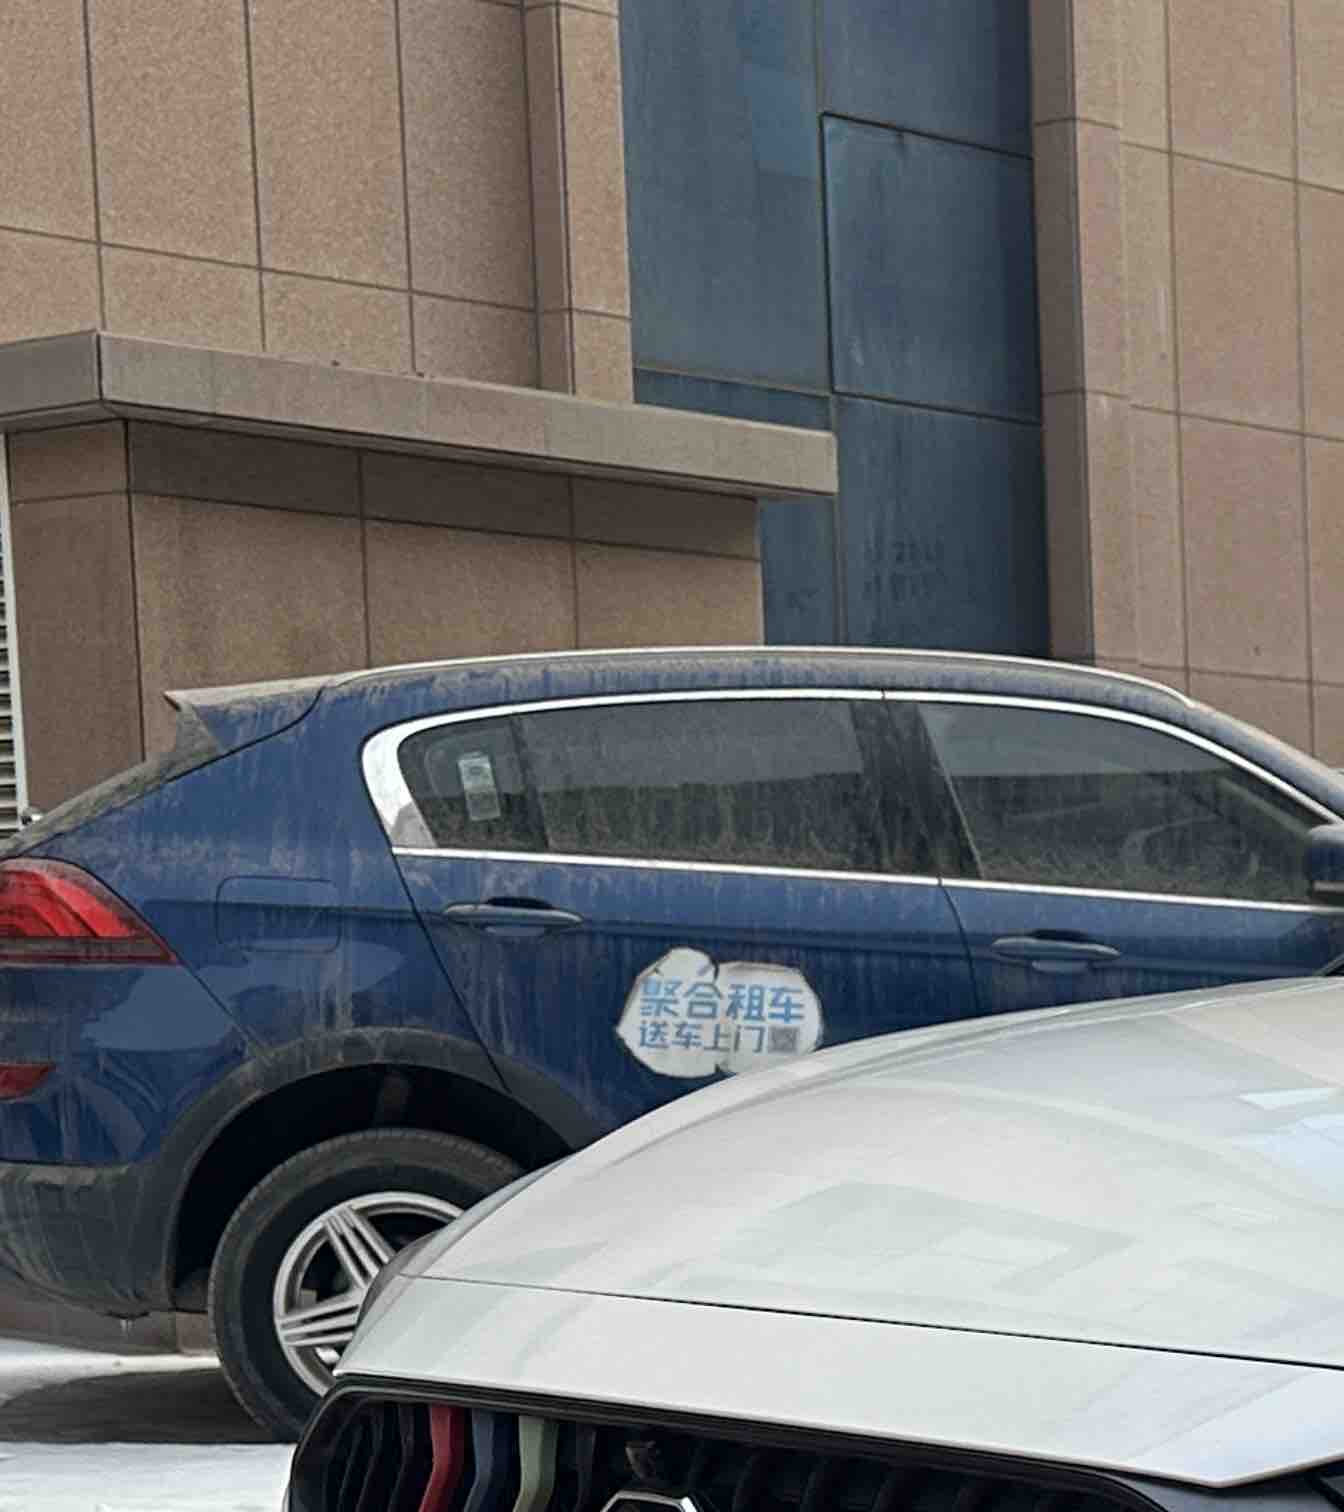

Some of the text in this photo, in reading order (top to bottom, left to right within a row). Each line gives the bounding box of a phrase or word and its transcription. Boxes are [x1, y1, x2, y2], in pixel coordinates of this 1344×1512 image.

[639, 977, 804, 1023] 聚合租车
[639, 1021, 767, 1052] 送车上门
